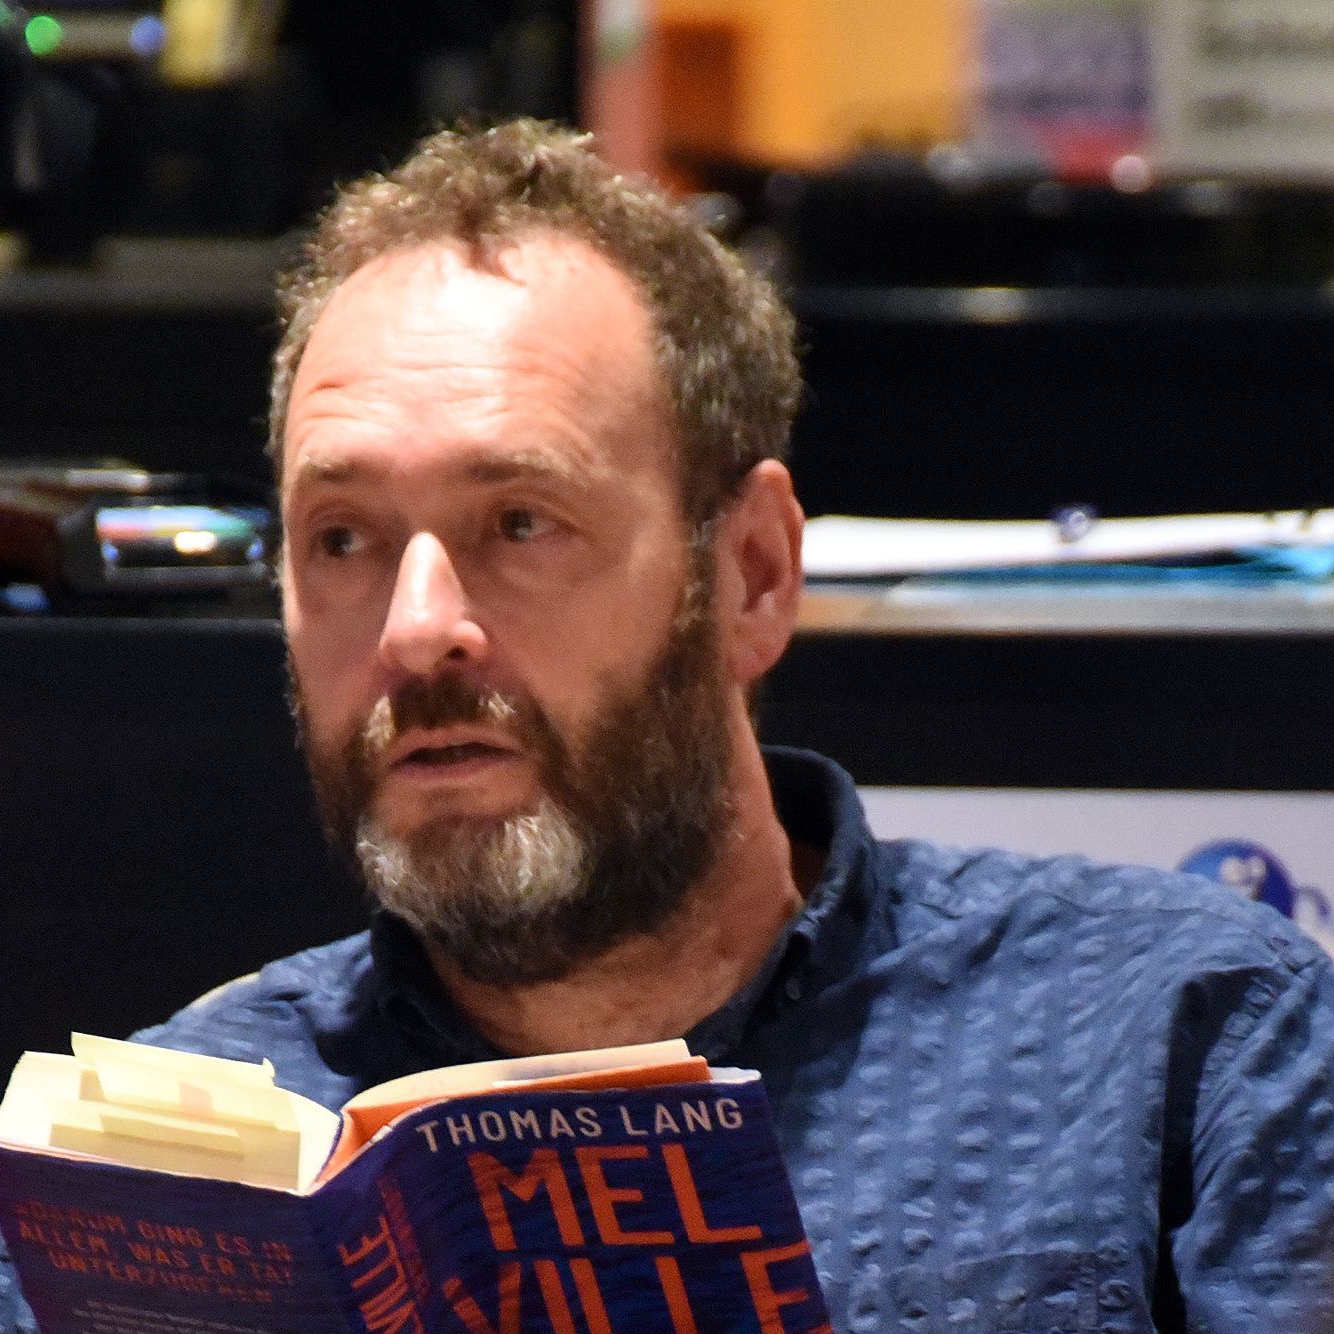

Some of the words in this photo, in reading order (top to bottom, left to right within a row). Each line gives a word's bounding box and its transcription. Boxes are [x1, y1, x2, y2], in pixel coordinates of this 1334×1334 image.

[416, 1106, 603, 1153] THOMAS
[620, 1098, 744, 1137] LANG
[468, 1143, 763, 1251] MEL
